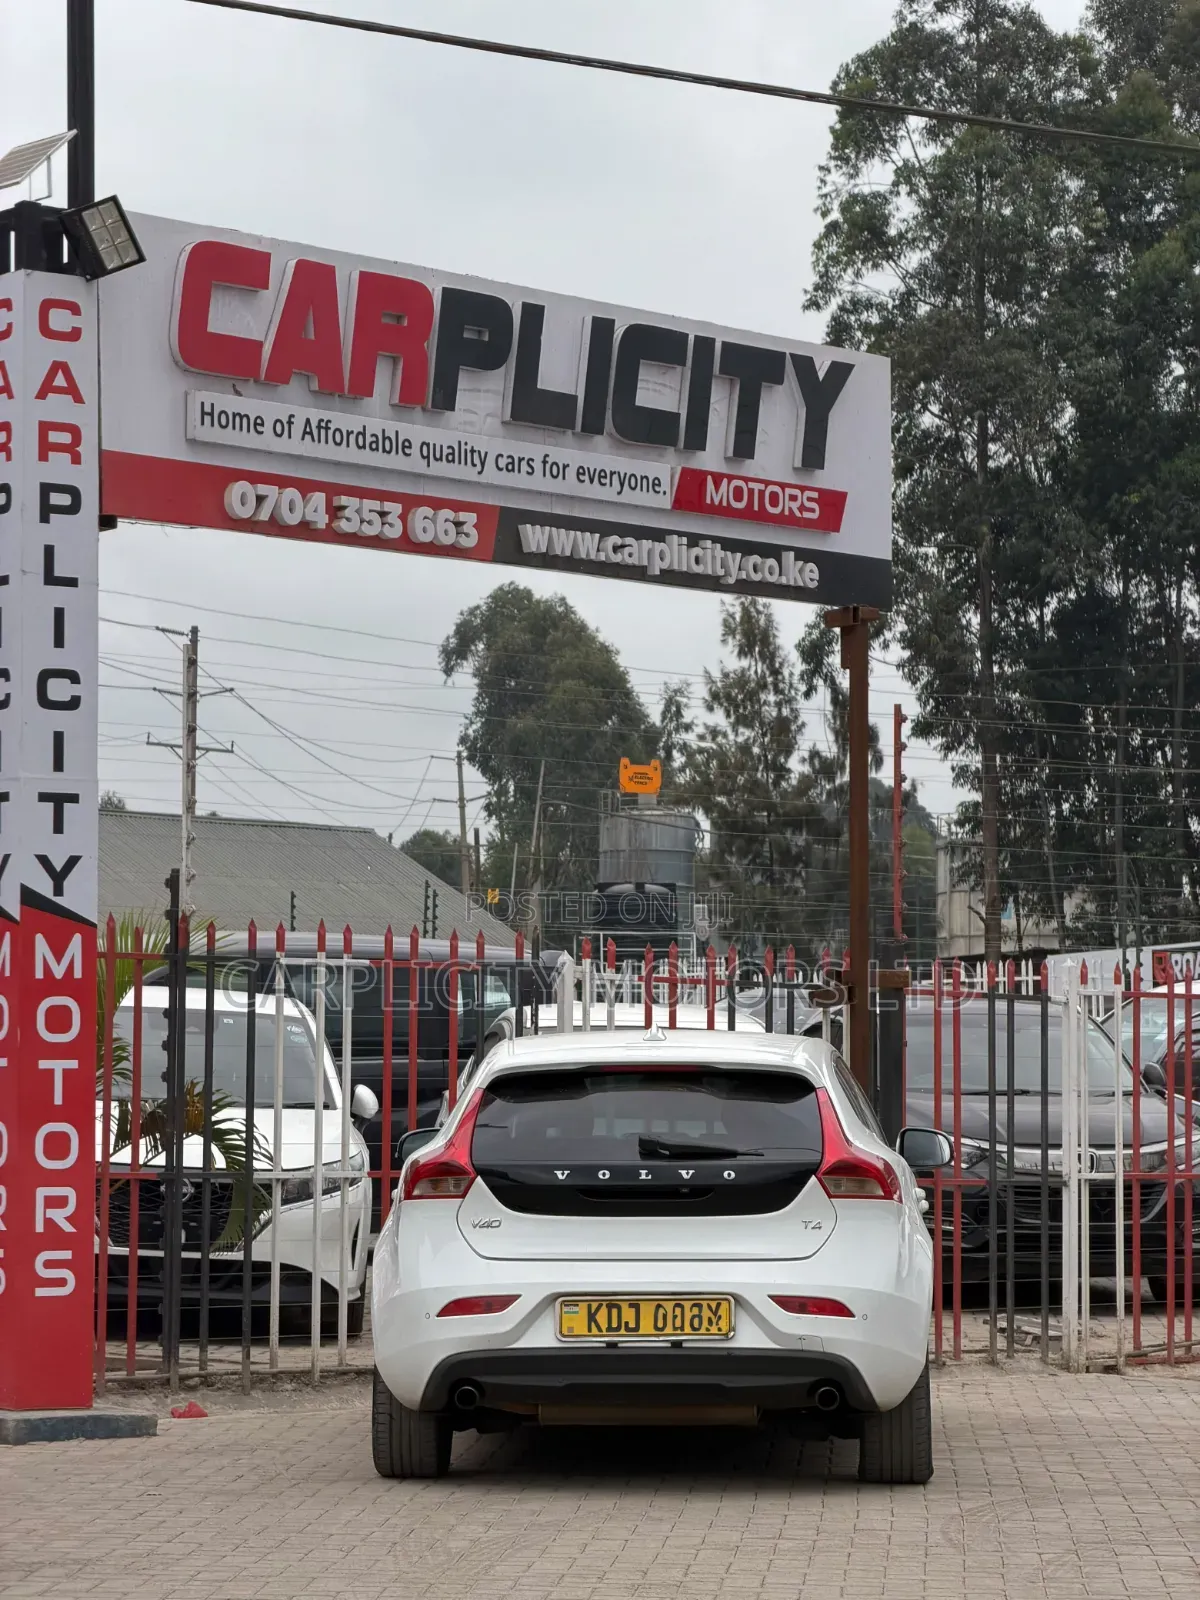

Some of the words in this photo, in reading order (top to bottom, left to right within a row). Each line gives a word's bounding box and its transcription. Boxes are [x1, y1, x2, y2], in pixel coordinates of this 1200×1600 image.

[172, 240, 855, 470] CARPLICITY
[200, 401, 265, 435] Home
[272, 414, 295, 439] of
[301, 417, 413, 457] Affordable
[419, 440, 488, 475] quality
[494, 452, 535, 476] cars
[541, 454, 570, 480] for
[576, 464, 667, 495] everyone.
[224, 480, 329, 529] 0704
[332, 495, 403, 540] 353
[407, 506, 479, 549] 663
[705, 475, 820, 520] MOTORS
[518, 524, 820, 588] www.carplicity.co.ke
[34, 298, 86, 897] CARPLICITY
[34, 932, 83, 1297] MOTORS
[554, 1169, 736, 1180] VOLVO
[470, 1217, 502, 1229] V40
[801, 1219, 823, 1230] T4
[587, 1303, 641, 1333] KDJ
